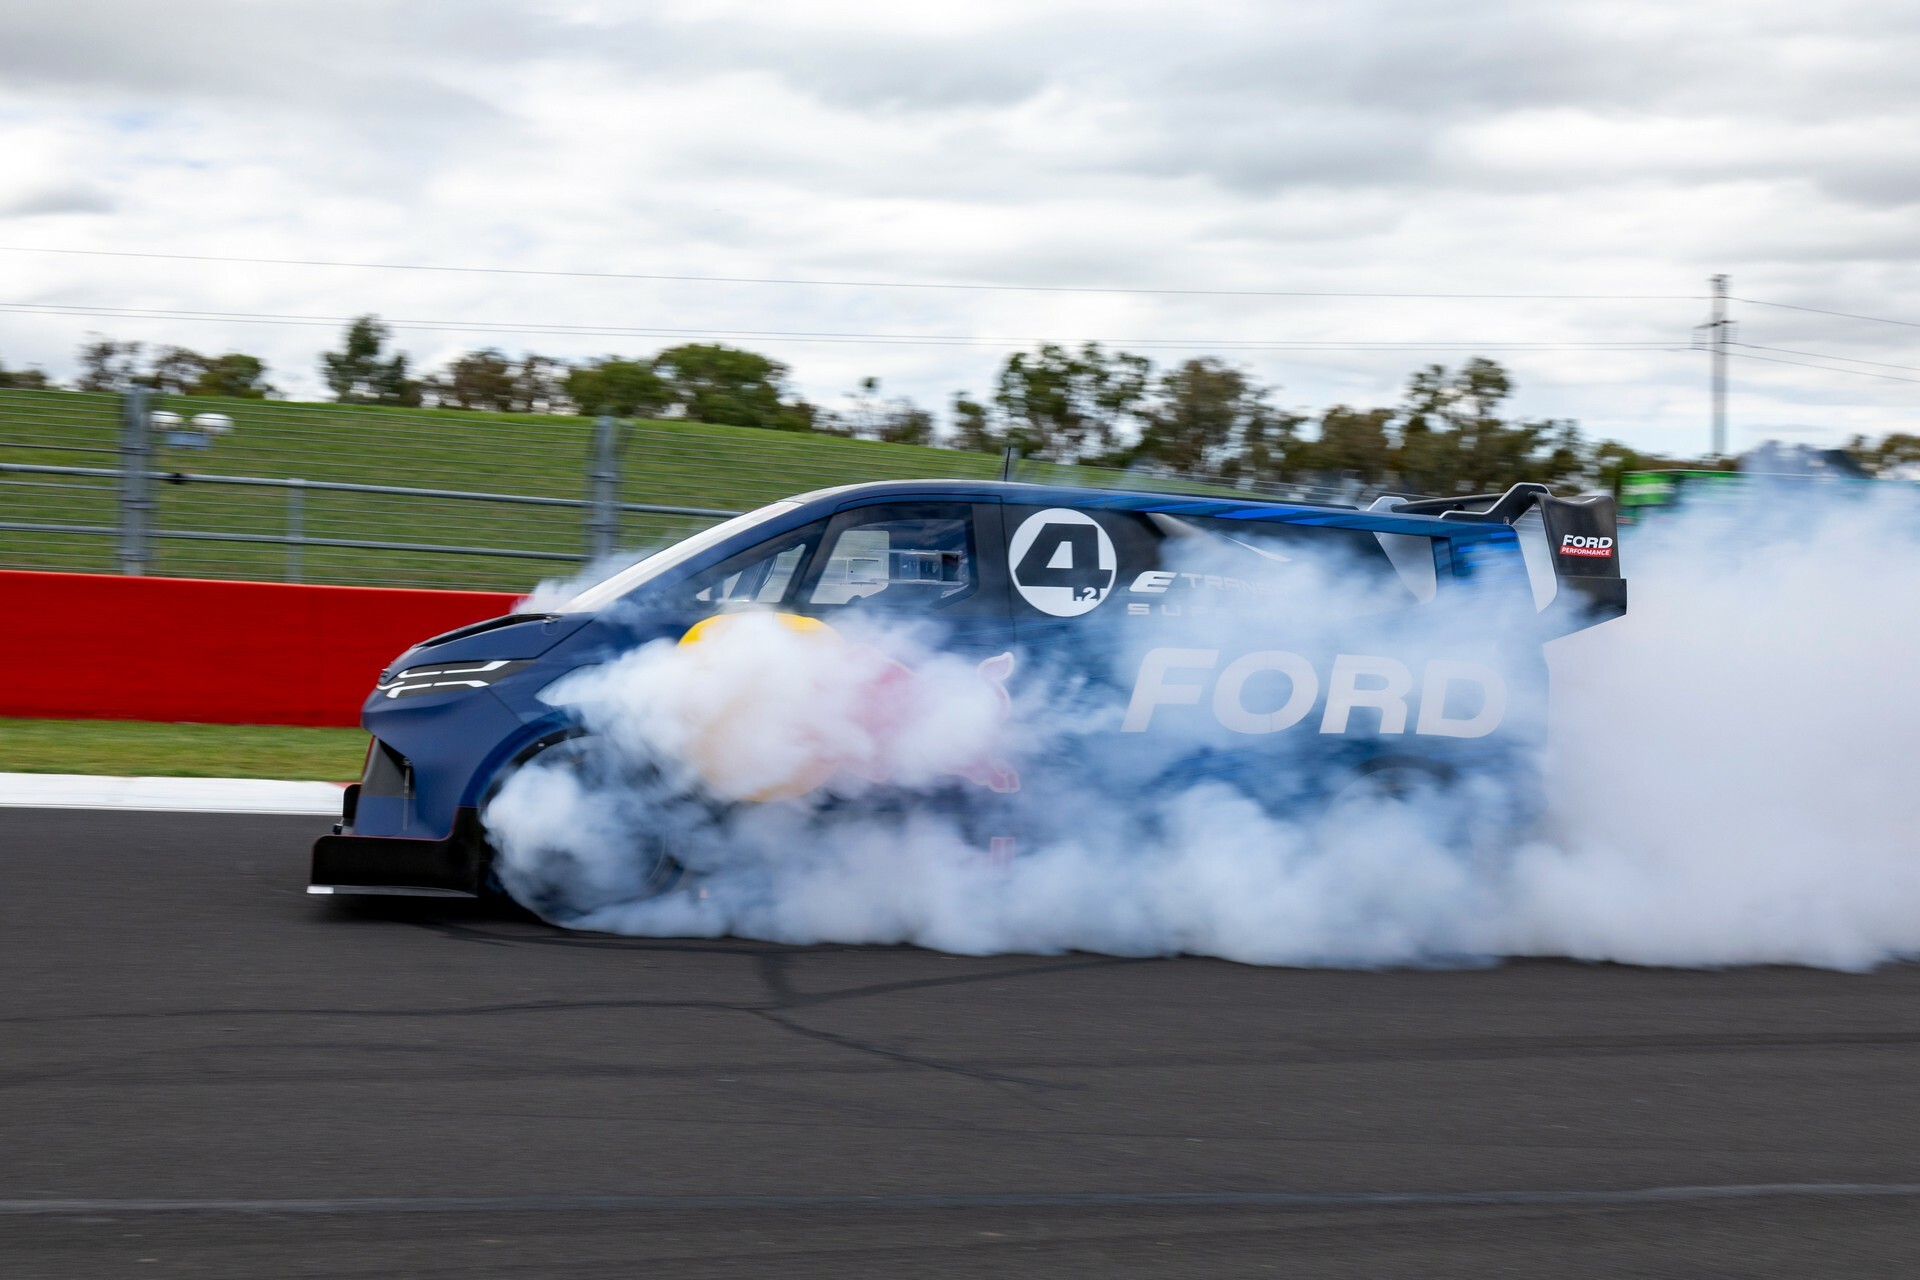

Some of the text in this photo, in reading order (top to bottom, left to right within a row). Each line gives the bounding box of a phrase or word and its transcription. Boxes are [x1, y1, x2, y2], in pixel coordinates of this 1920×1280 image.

[1562, 534, 1613, 549] FORD
[1561, 546, 1610, 556] PERFORMANCE
[1120, 647, 1507, 738] FORD
